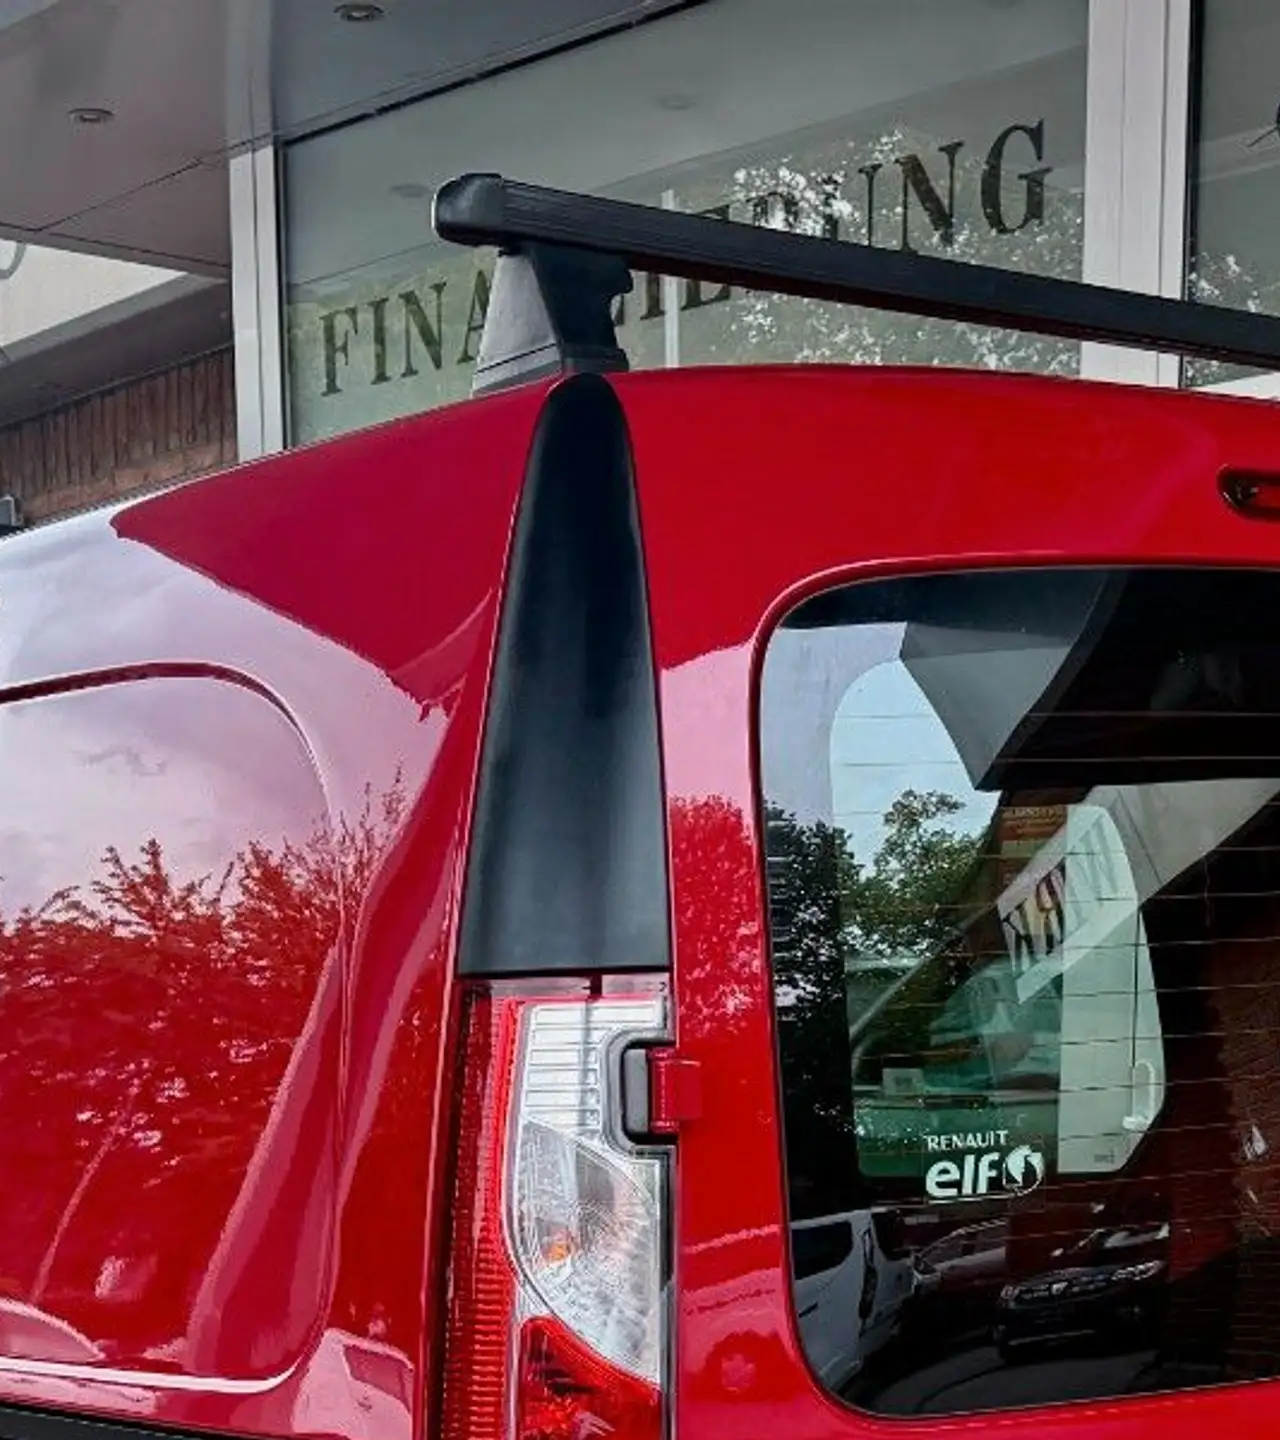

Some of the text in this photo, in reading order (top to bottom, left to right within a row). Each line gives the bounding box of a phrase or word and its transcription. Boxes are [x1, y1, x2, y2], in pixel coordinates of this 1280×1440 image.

[320, 117, 1054, 398] FINAUNG
[926, 1129, 1009, 1151] RENAULT
[925, 1151, 1000, 1198] elf
